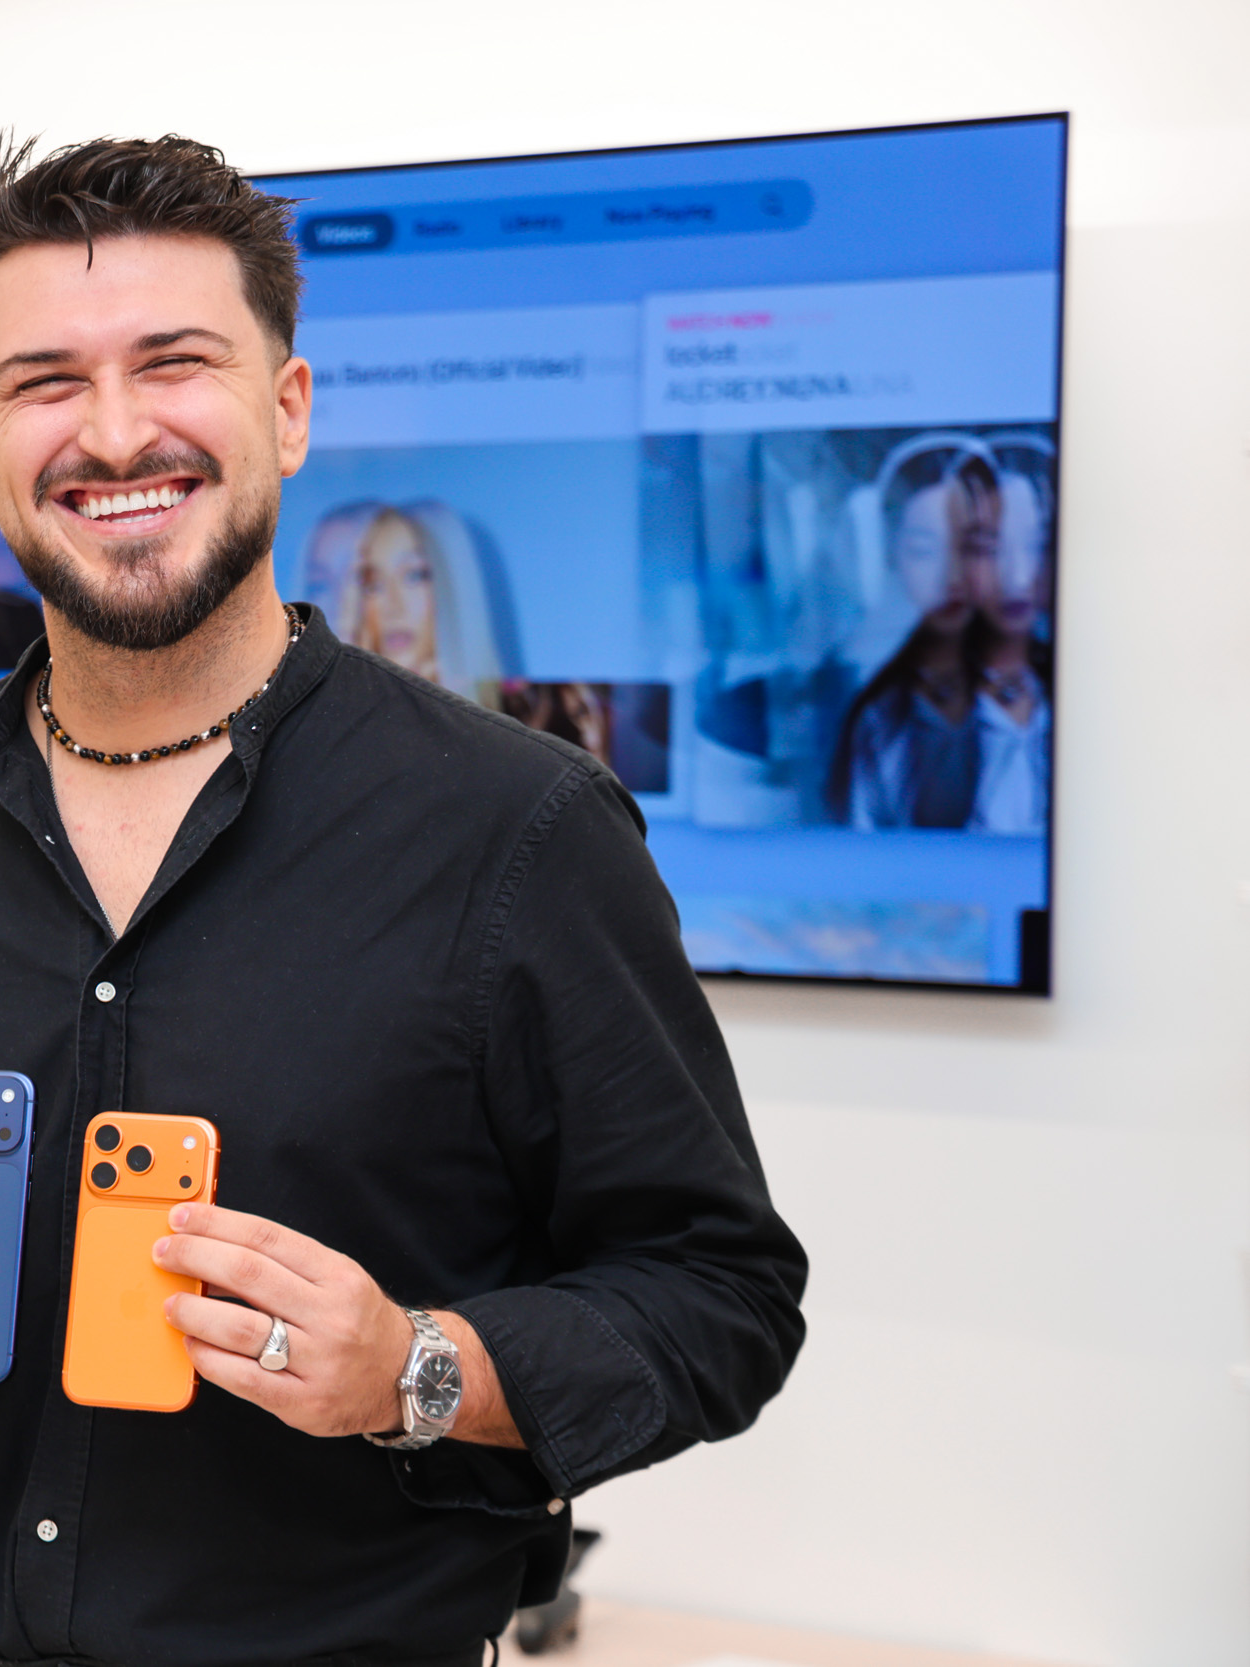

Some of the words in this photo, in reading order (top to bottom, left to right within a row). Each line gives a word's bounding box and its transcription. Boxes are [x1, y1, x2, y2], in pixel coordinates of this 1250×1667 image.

[502, 213, 565, 234] Library
[606, 207, 646, 224] Now
[649, 202, 715, 223] Playing
[314, 224, 377, 246] Videos
